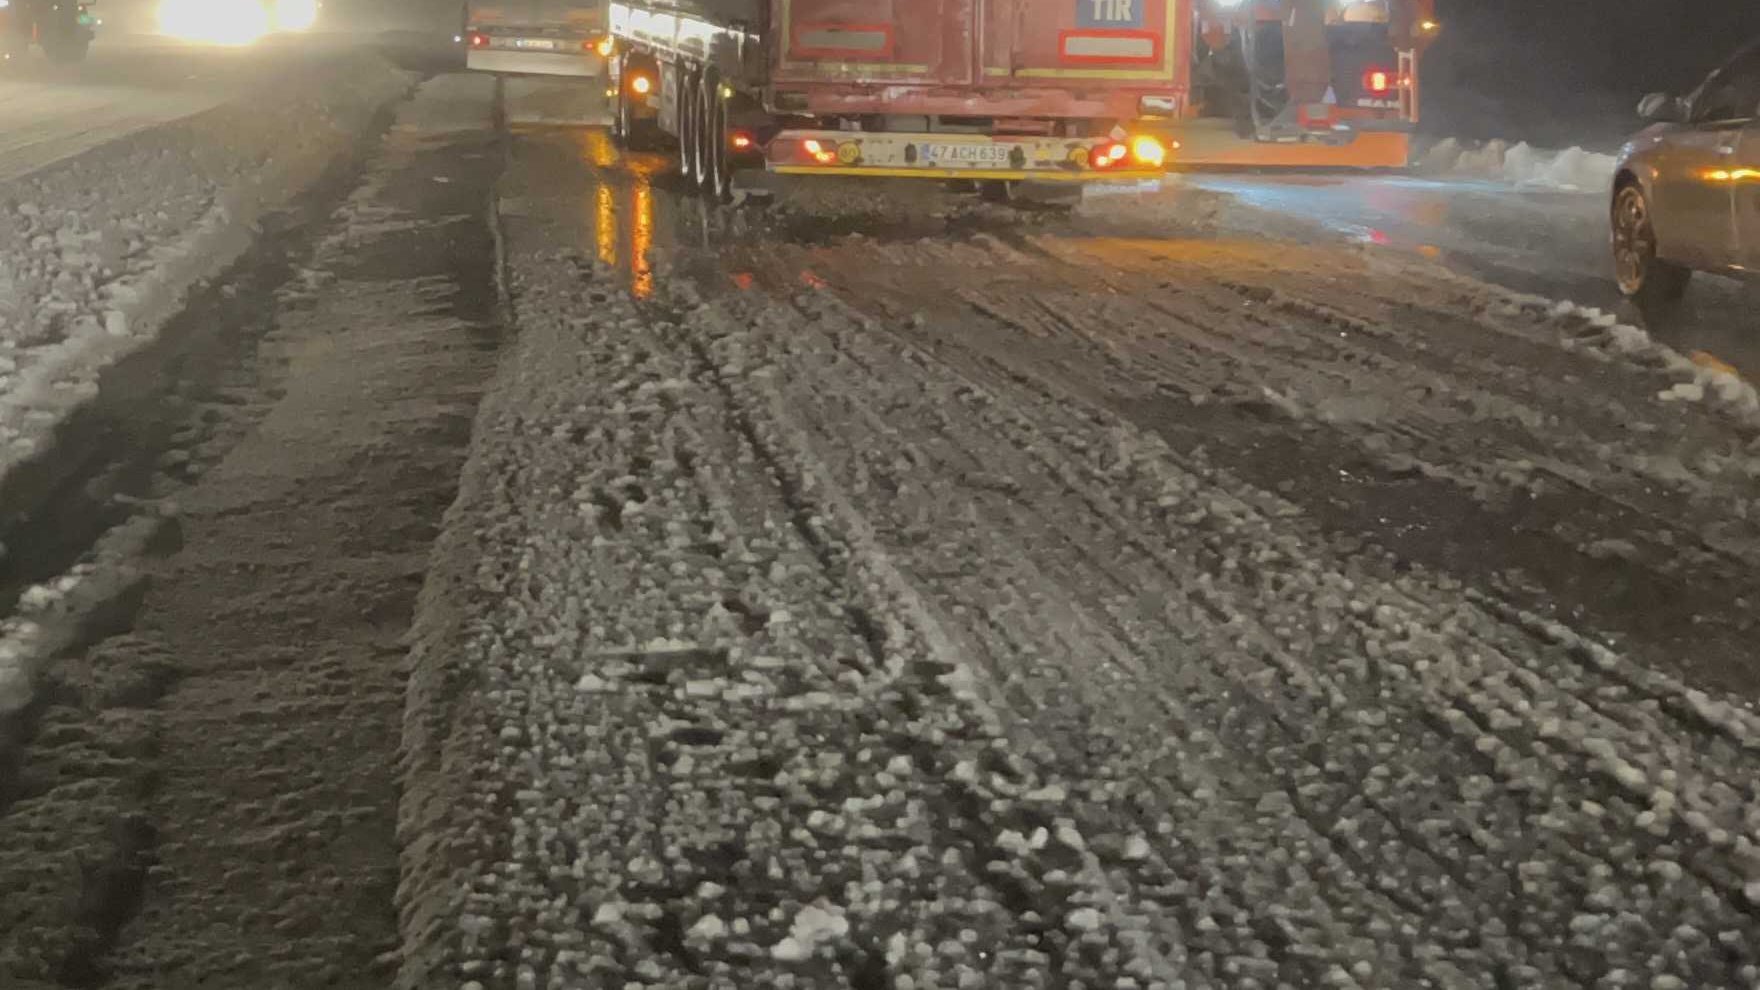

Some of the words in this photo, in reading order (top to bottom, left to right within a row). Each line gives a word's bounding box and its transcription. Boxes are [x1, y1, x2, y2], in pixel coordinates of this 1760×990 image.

[929, 145, 947, 159] 47
[951, 147, 976, 160] ACH
[980, 147, 1007, 161] 639
